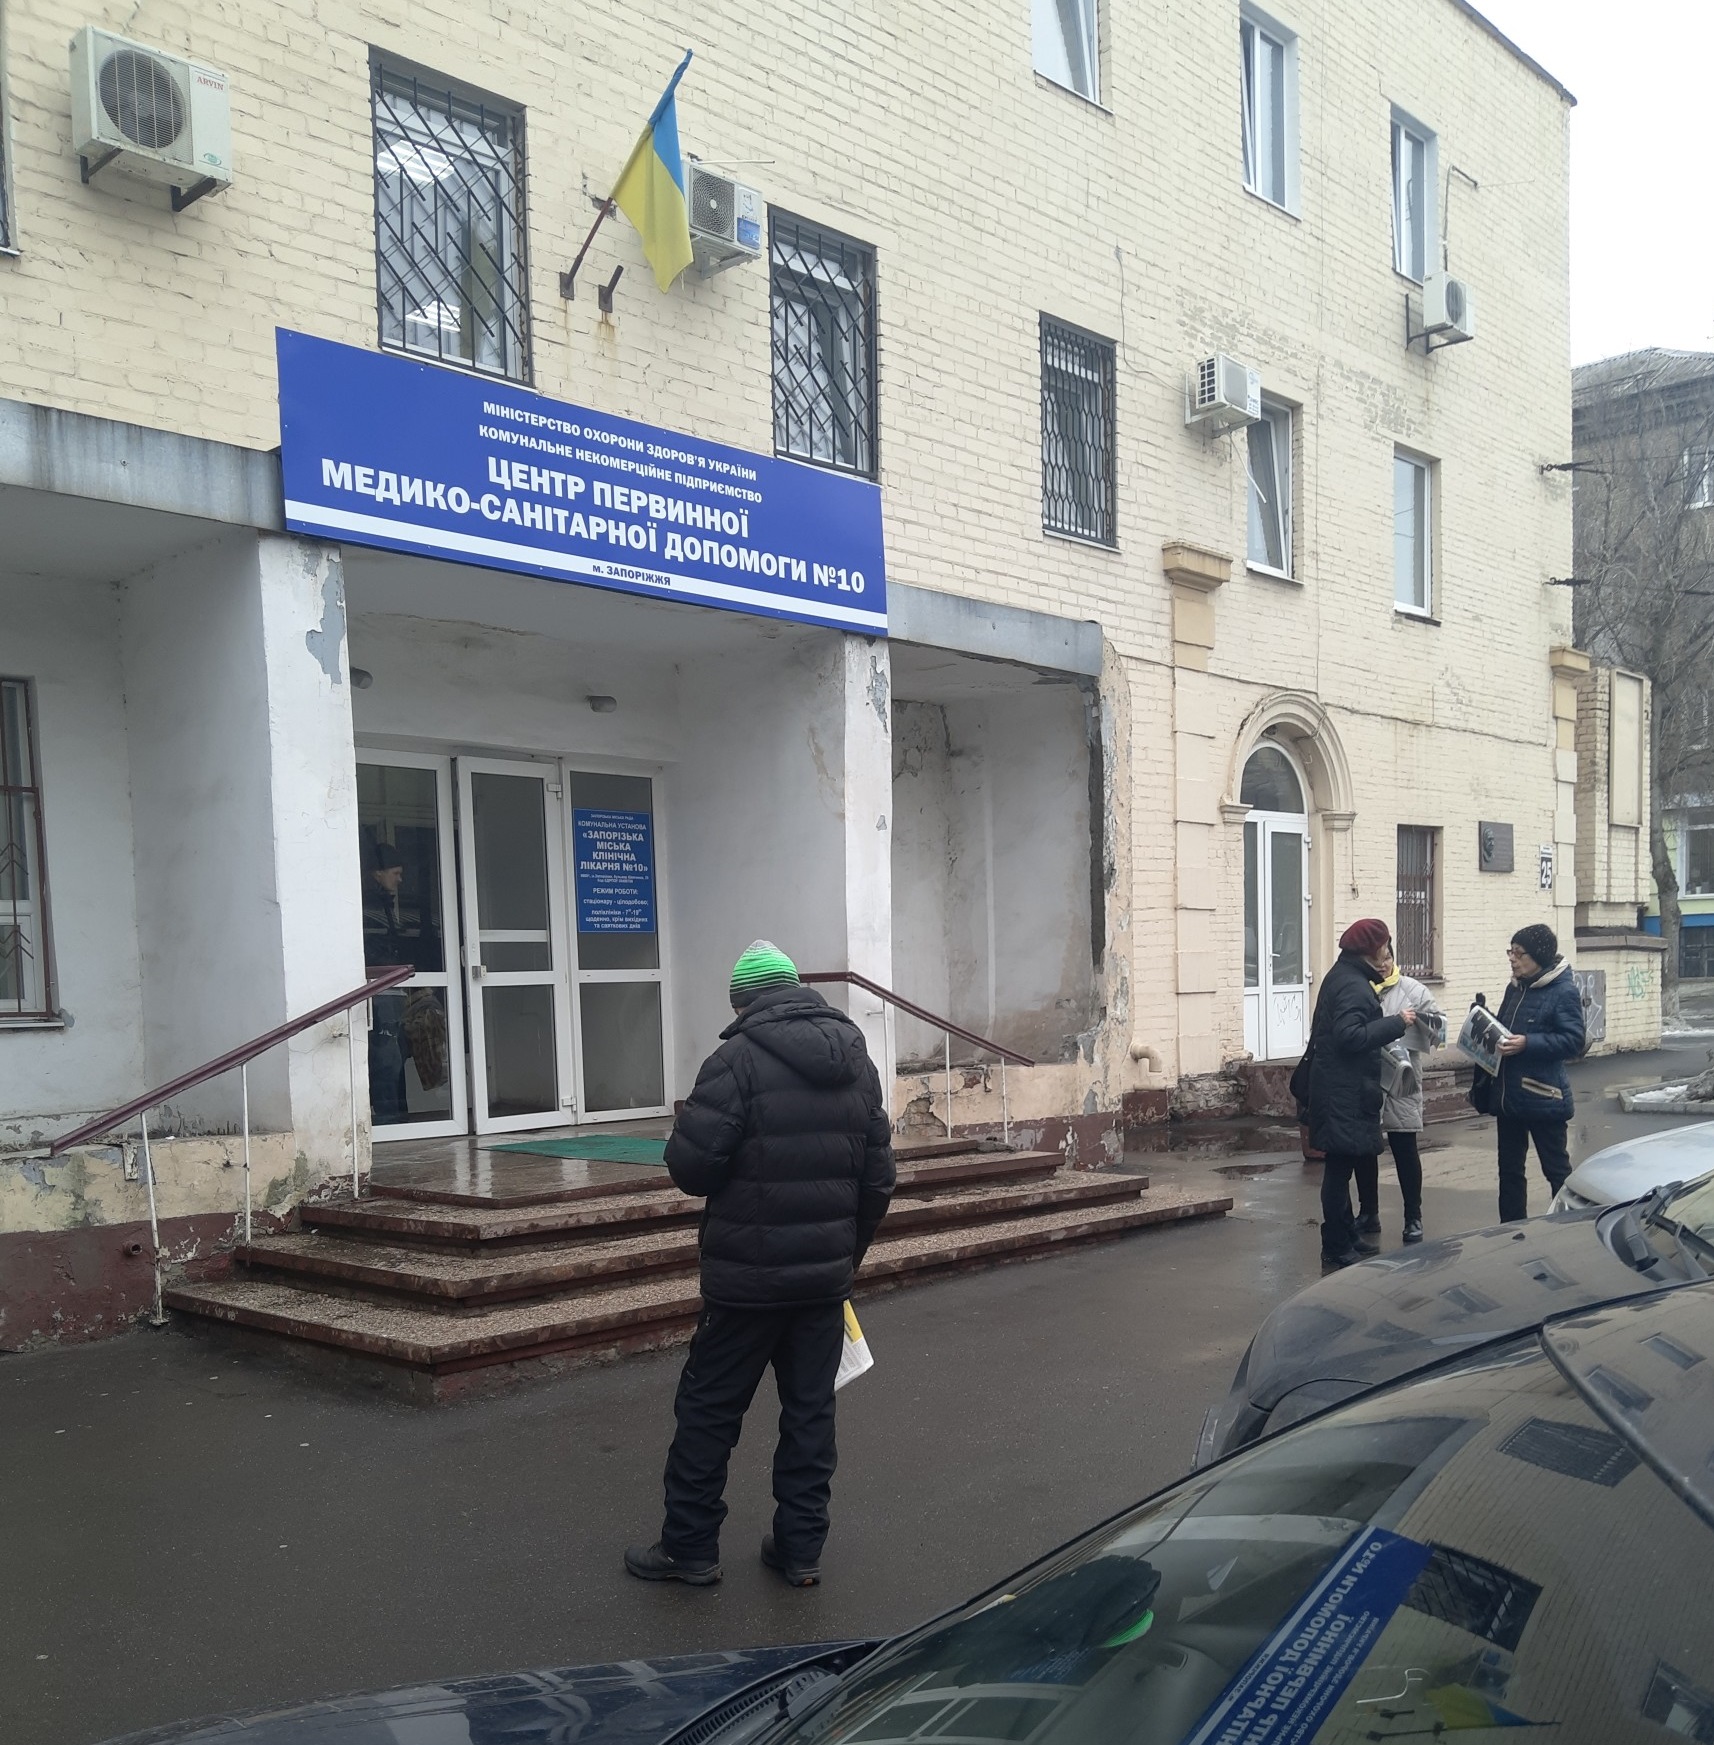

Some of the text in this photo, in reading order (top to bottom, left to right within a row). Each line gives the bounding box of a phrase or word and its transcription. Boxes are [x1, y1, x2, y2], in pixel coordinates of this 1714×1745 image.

[196, 76, 224, 91] ARVIN
[483, 401, 581, 437] МІНІСТЕРСТВО
[583, 426, 645, 453] ОХОРОНИ
[708, 457, 757, 482] УКРАЇНИ
[479, 425, 763, 504] КОМУНАЛЬНЕ НЕКОМЕРЦІЙНЕ ПІДПРИЄМСТВО
[488, 456, 749, 538] ЦЕНТР ПЕРВИННОЇ
[321, 458, 865, 594] МЕДИКО-САНІТАРНОЇ ДОПОМОГИ №10
[592, 563, 671, 587] м. ЗАПОРІЖЖЯ
[578, 821, 647, 831] КОМУНАЛЬНА УСТАНОВА
[582, 830, 644, 842] «ЗАПОРІЗЬКА
[596, 841, 631, 851] МІСЬКА
[592, 851, 636, 861] КЛІНІЧНА
[580, 861, 621, 871] ЛІКАРНЯ
[1541, 861, 1552, 885] 25
